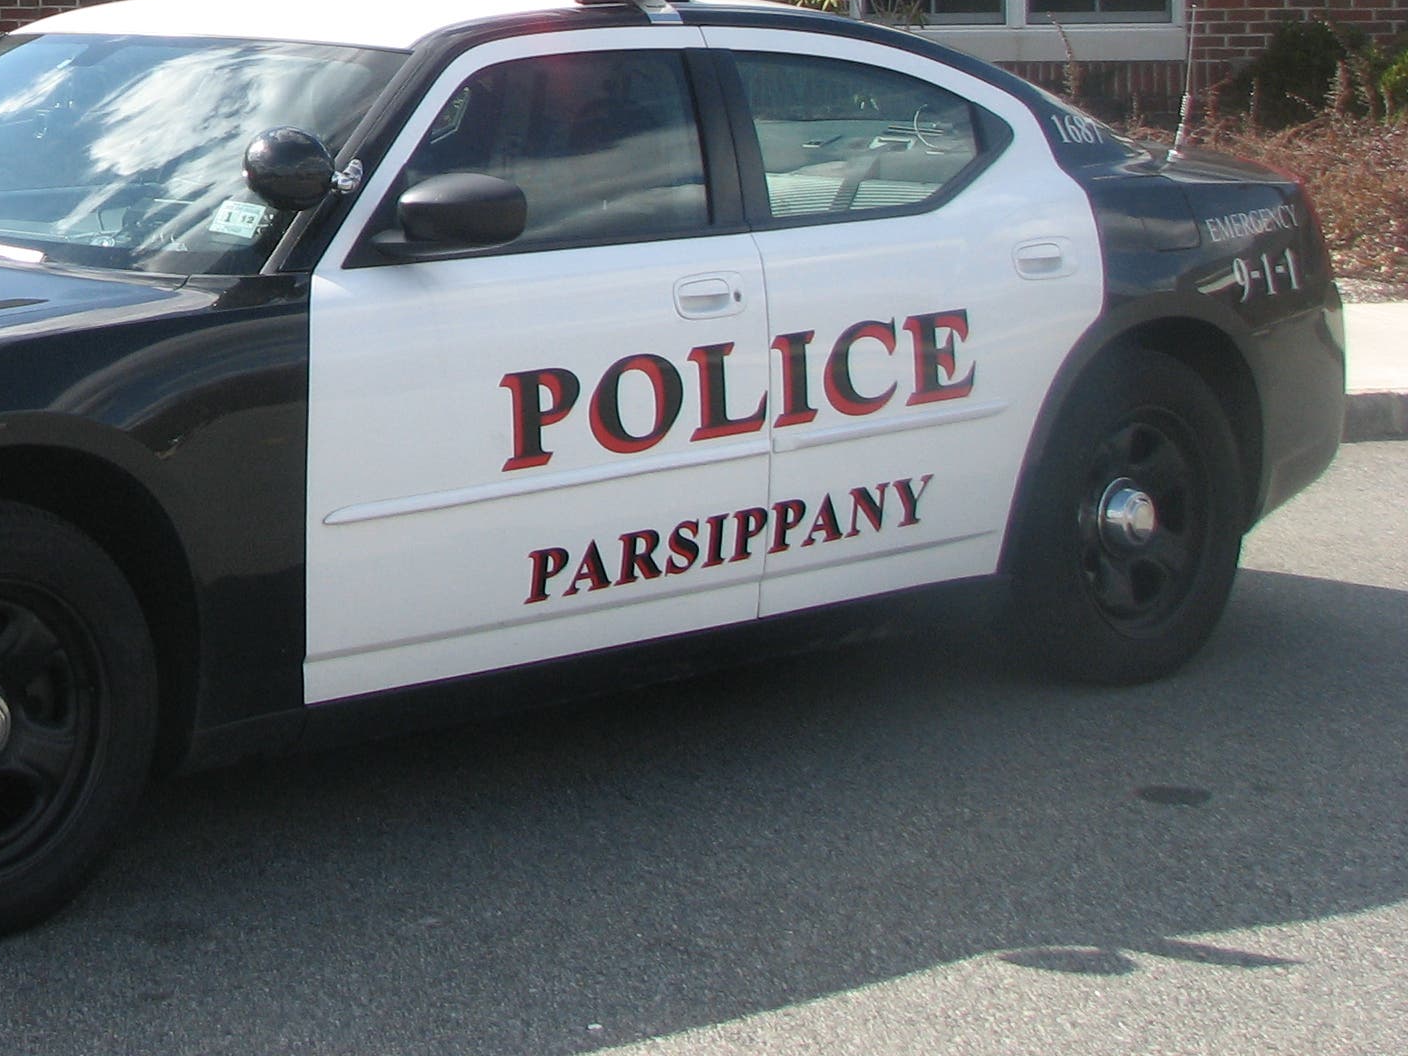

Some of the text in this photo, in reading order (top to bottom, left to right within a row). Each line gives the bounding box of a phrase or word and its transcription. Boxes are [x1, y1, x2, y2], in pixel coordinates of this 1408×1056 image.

[1050, 114, 1103, 144] 1687
[1205, 203, 1299, 242] EMERGENCY
[1233, 248, 1298, 303] 9-1-1
[498, 308, 976, 472] POLICE
[523, 473, 935, 605] PARSIPPANY
